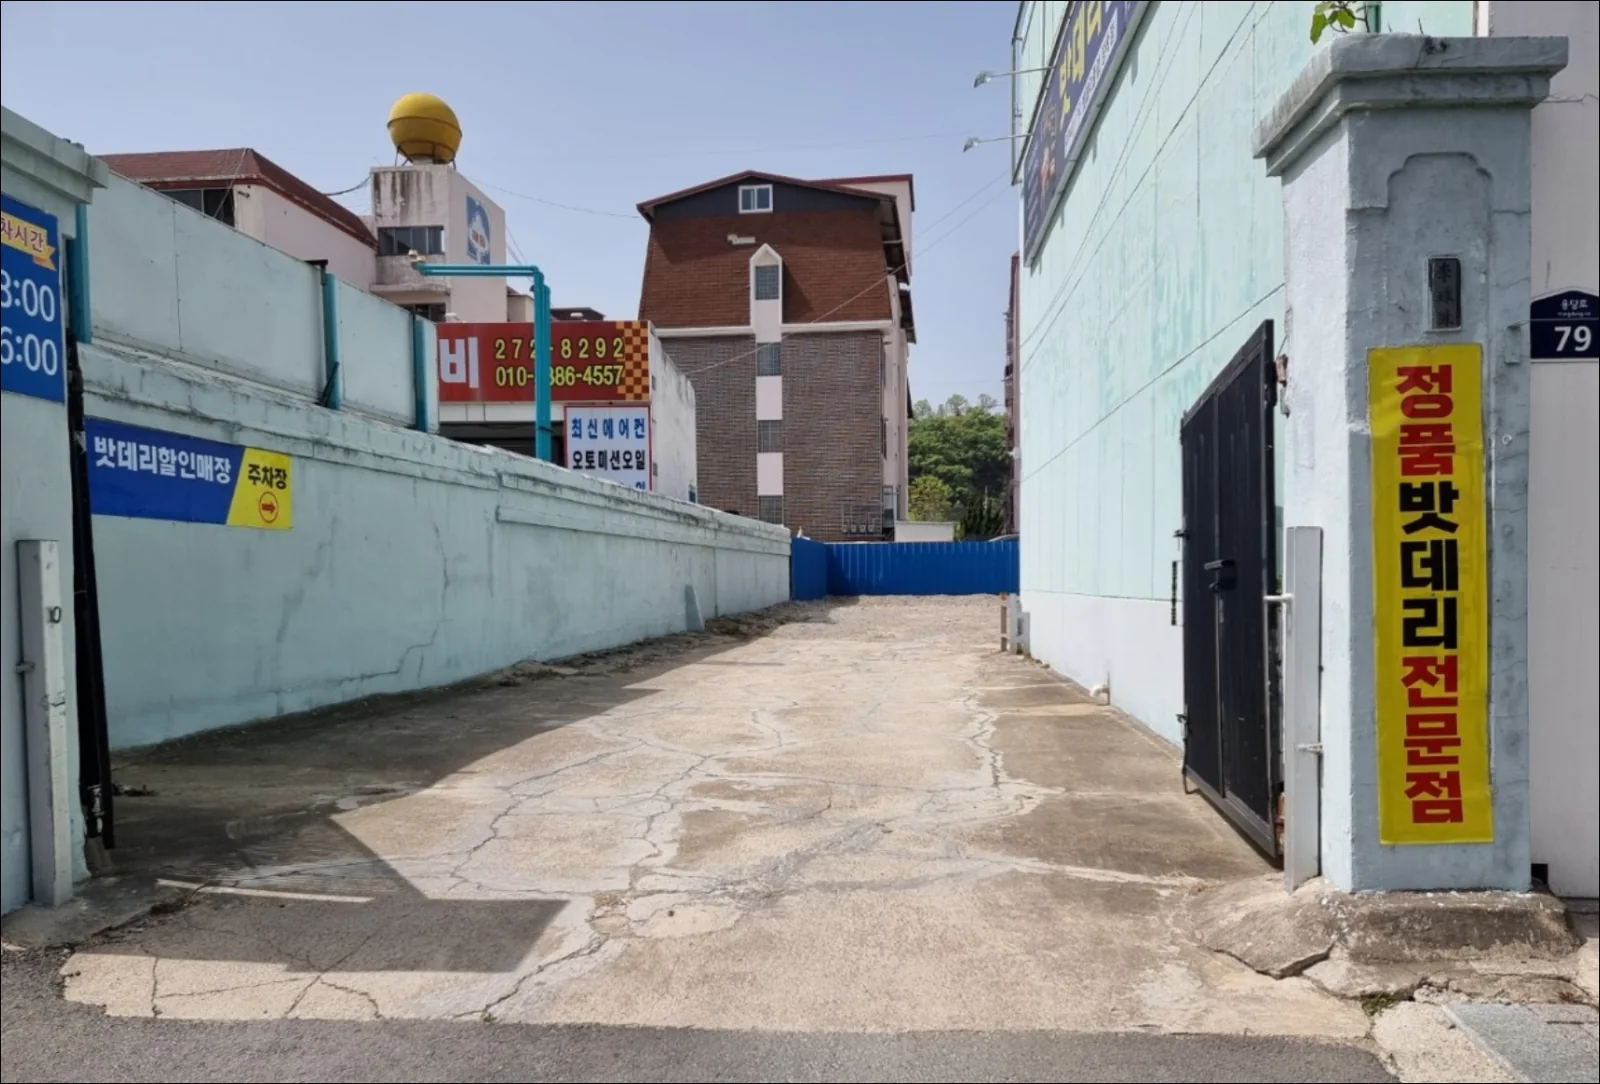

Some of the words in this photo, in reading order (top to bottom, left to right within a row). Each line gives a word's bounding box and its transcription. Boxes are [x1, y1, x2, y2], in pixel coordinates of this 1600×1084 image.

[1554, 326, 1592, 352] 79
[439, 337, 479, 388] 비
[94, 436, 231, 484] 밧데리할인매장
[248, 463, 287, 490] 주차장
[573, 448, 645, 470] 오토미션오일
[1396, 364, 1463, 823] 정품밧데리전문점
